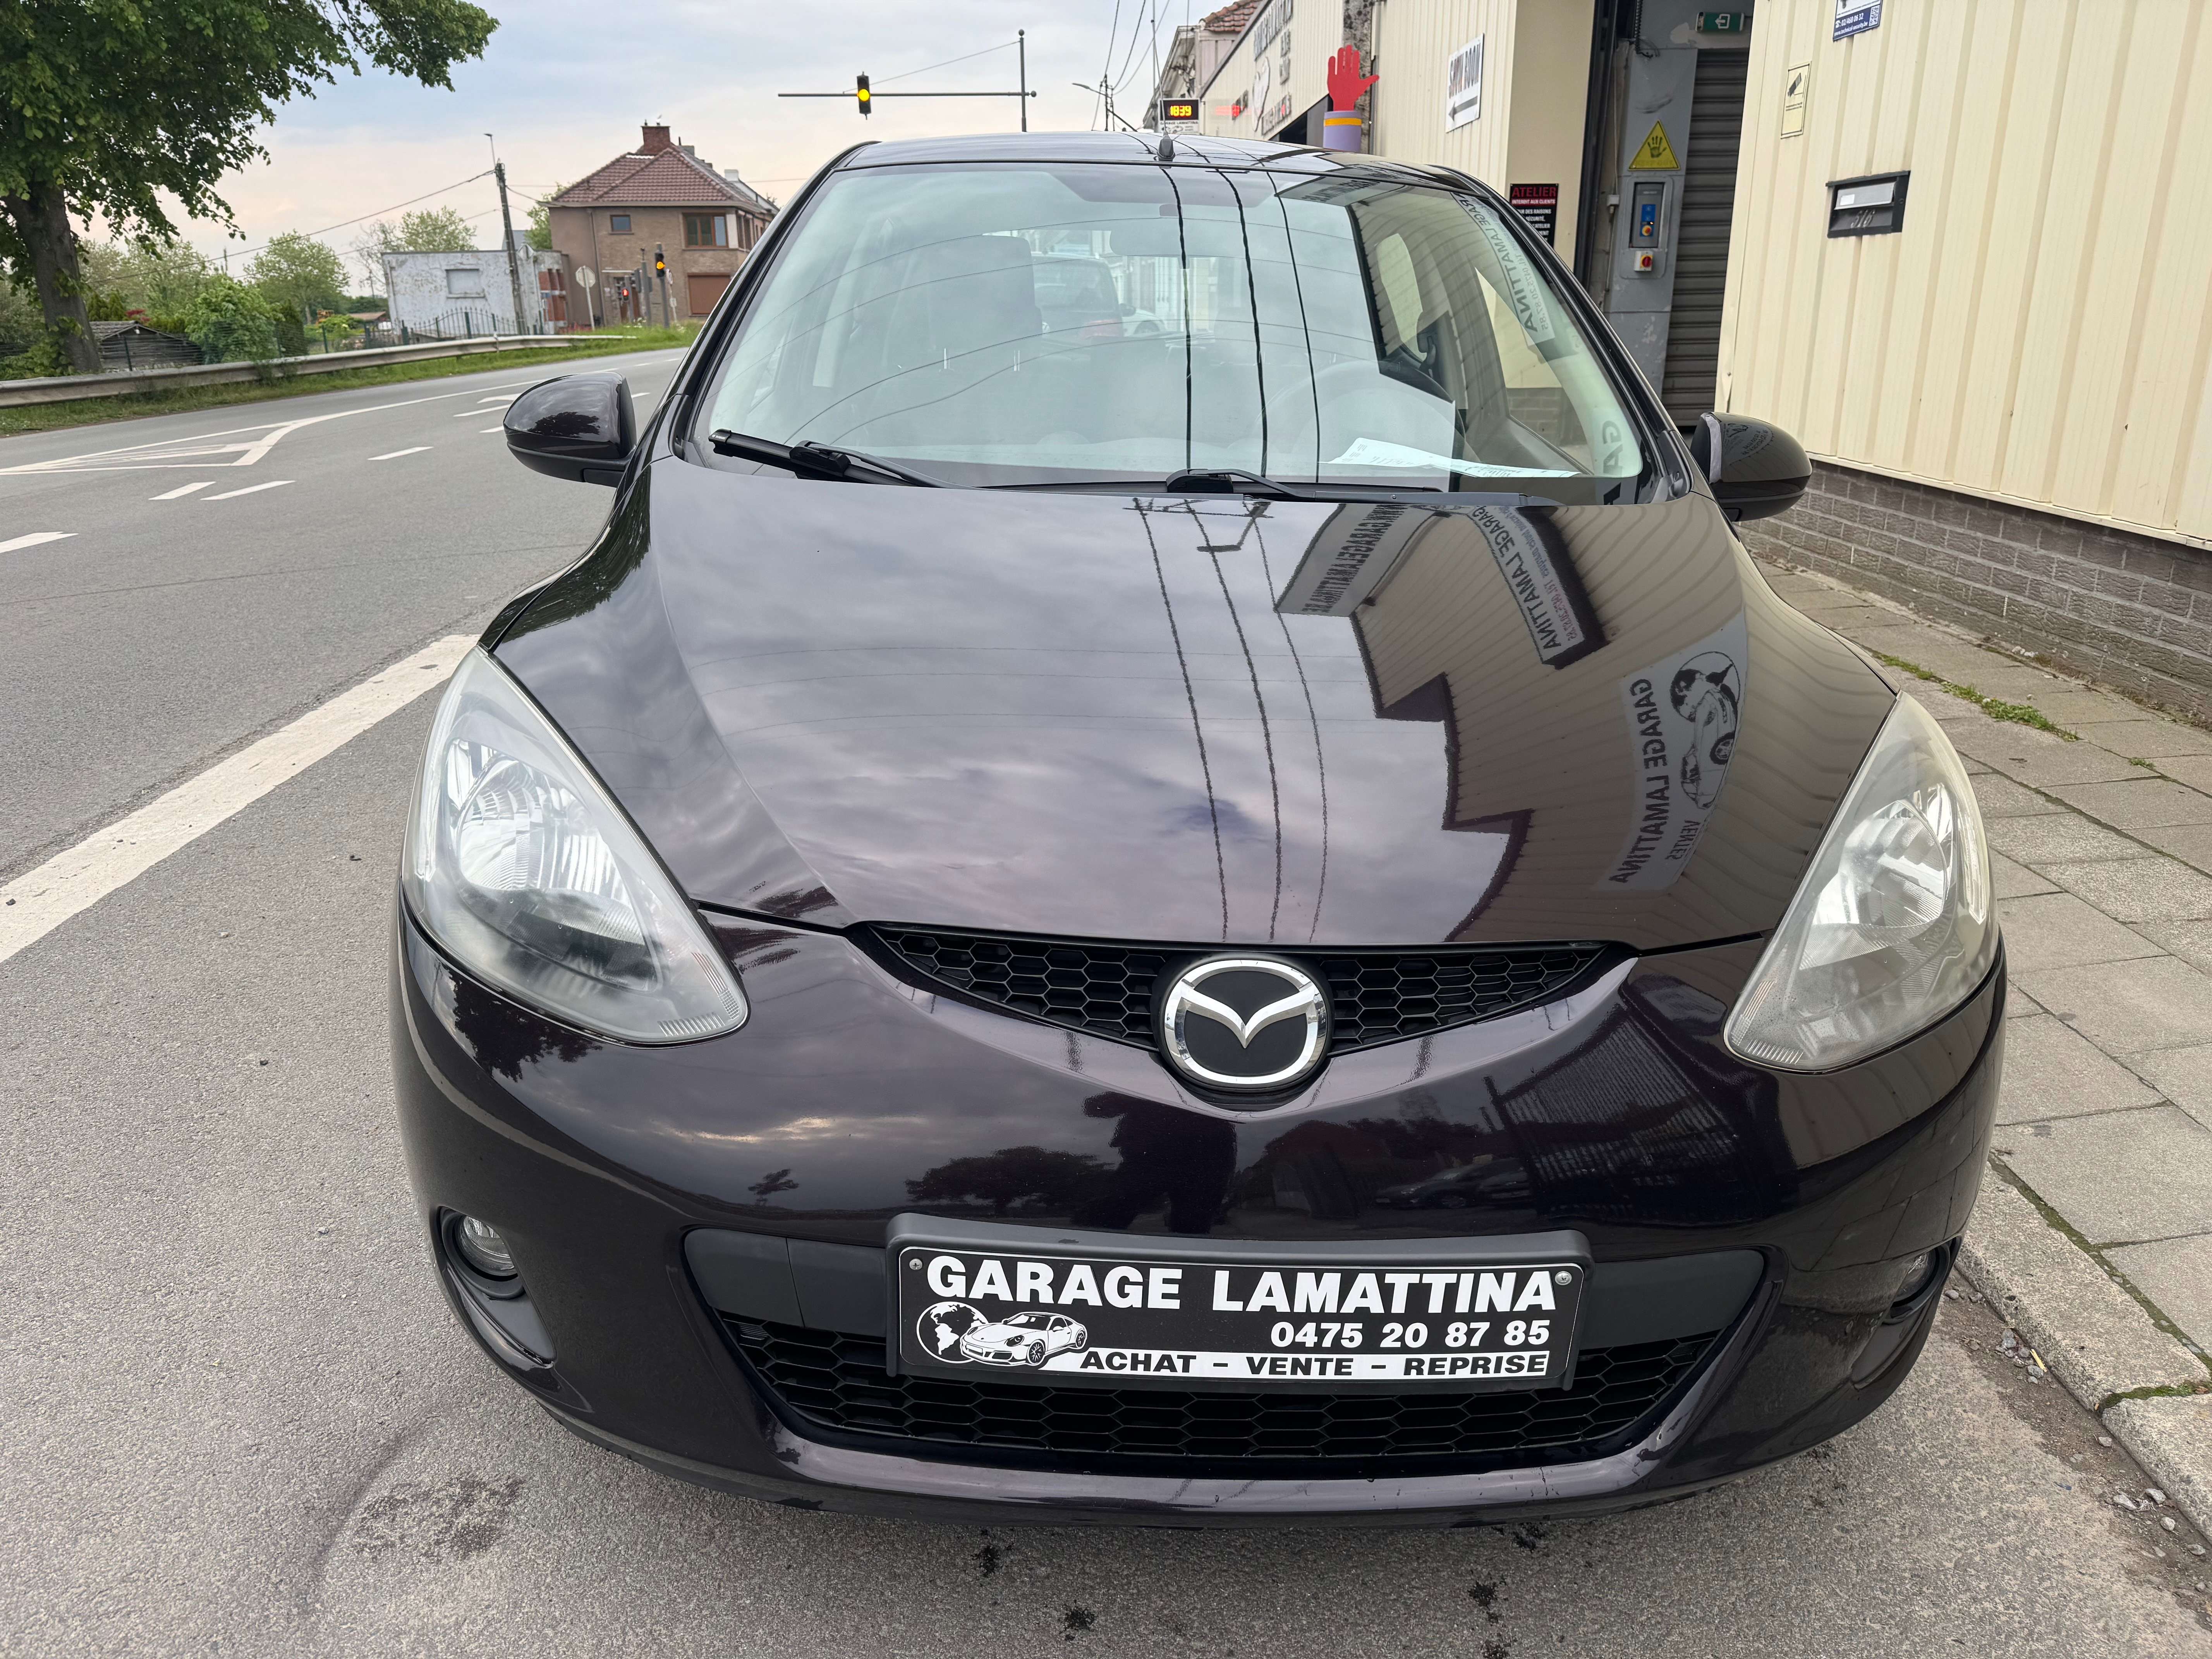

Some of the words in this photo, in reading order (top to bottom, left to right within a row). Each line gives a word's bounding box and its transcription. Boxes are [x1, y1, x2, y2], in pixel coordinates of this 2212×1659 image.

[1449, 52, 1464, 99] SHOW
[1464, 43, 1481, 90] ROOM
[1512, 187, 1556, 197] ATELIER
[927, 1255, 1182, 1310] GARAGE
[1212, 1270, 1556, 1314] LAMATTINA
[1271, 1321, 1363, 1348] 0475
[1380, 1322, 1428, 1348] 20
[1444, 1322, 1490, 1347] 87
[1504, 1320, 1550, 1345] 85
[1080, 1351, 1196, 1373] ACHAT
[1246, 1357, 1354, 1376] VENTE
[1403, 1354, 1547, 1376] REPRISE
